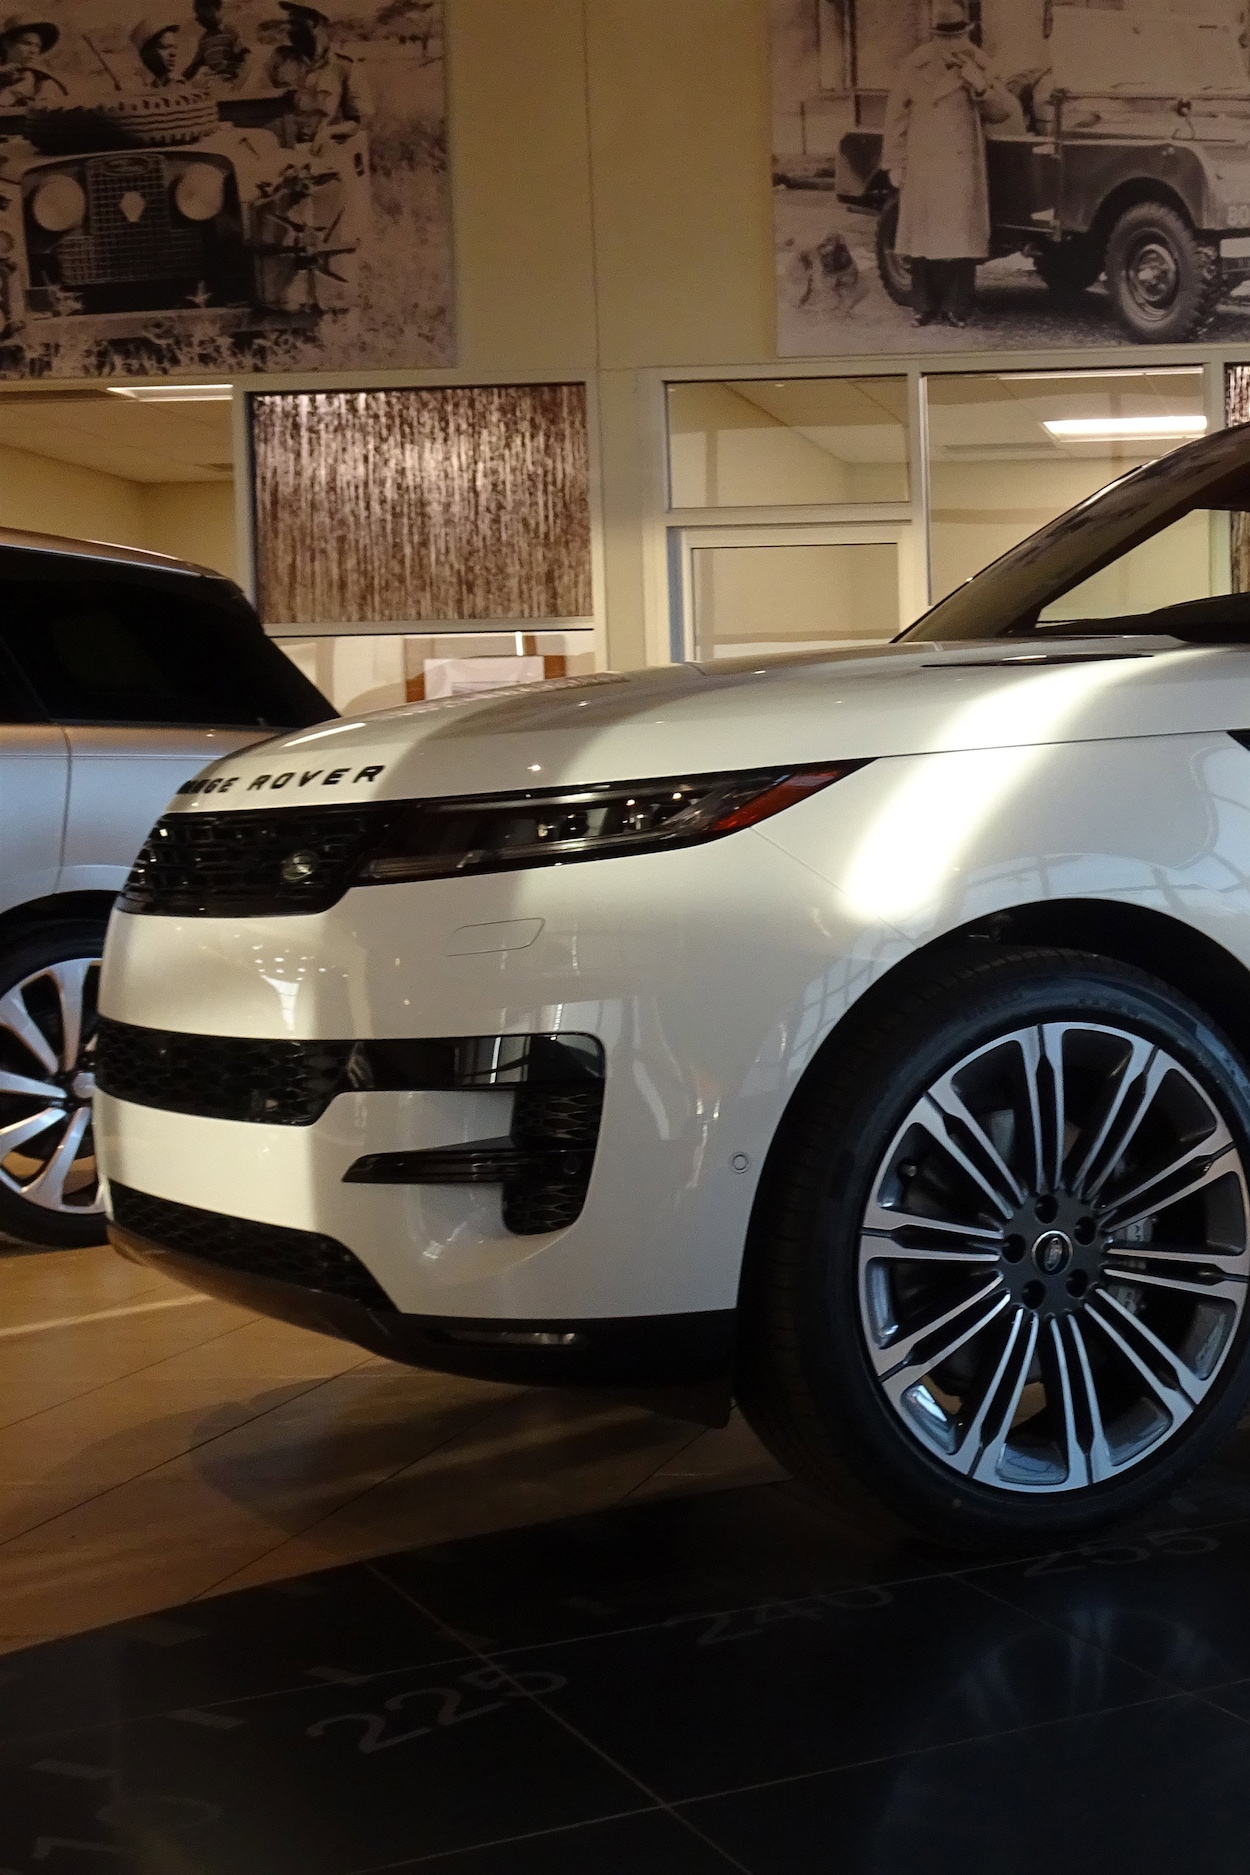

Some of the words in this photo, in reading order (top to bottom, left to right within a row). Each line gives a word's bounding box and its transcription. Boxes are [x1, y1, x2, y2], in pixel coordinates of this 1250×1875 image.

[247, 765, 386, 791] ROVER
[1023, 1528, 1221, 1577] 255
[305, 1662, 569, 1755] 225
